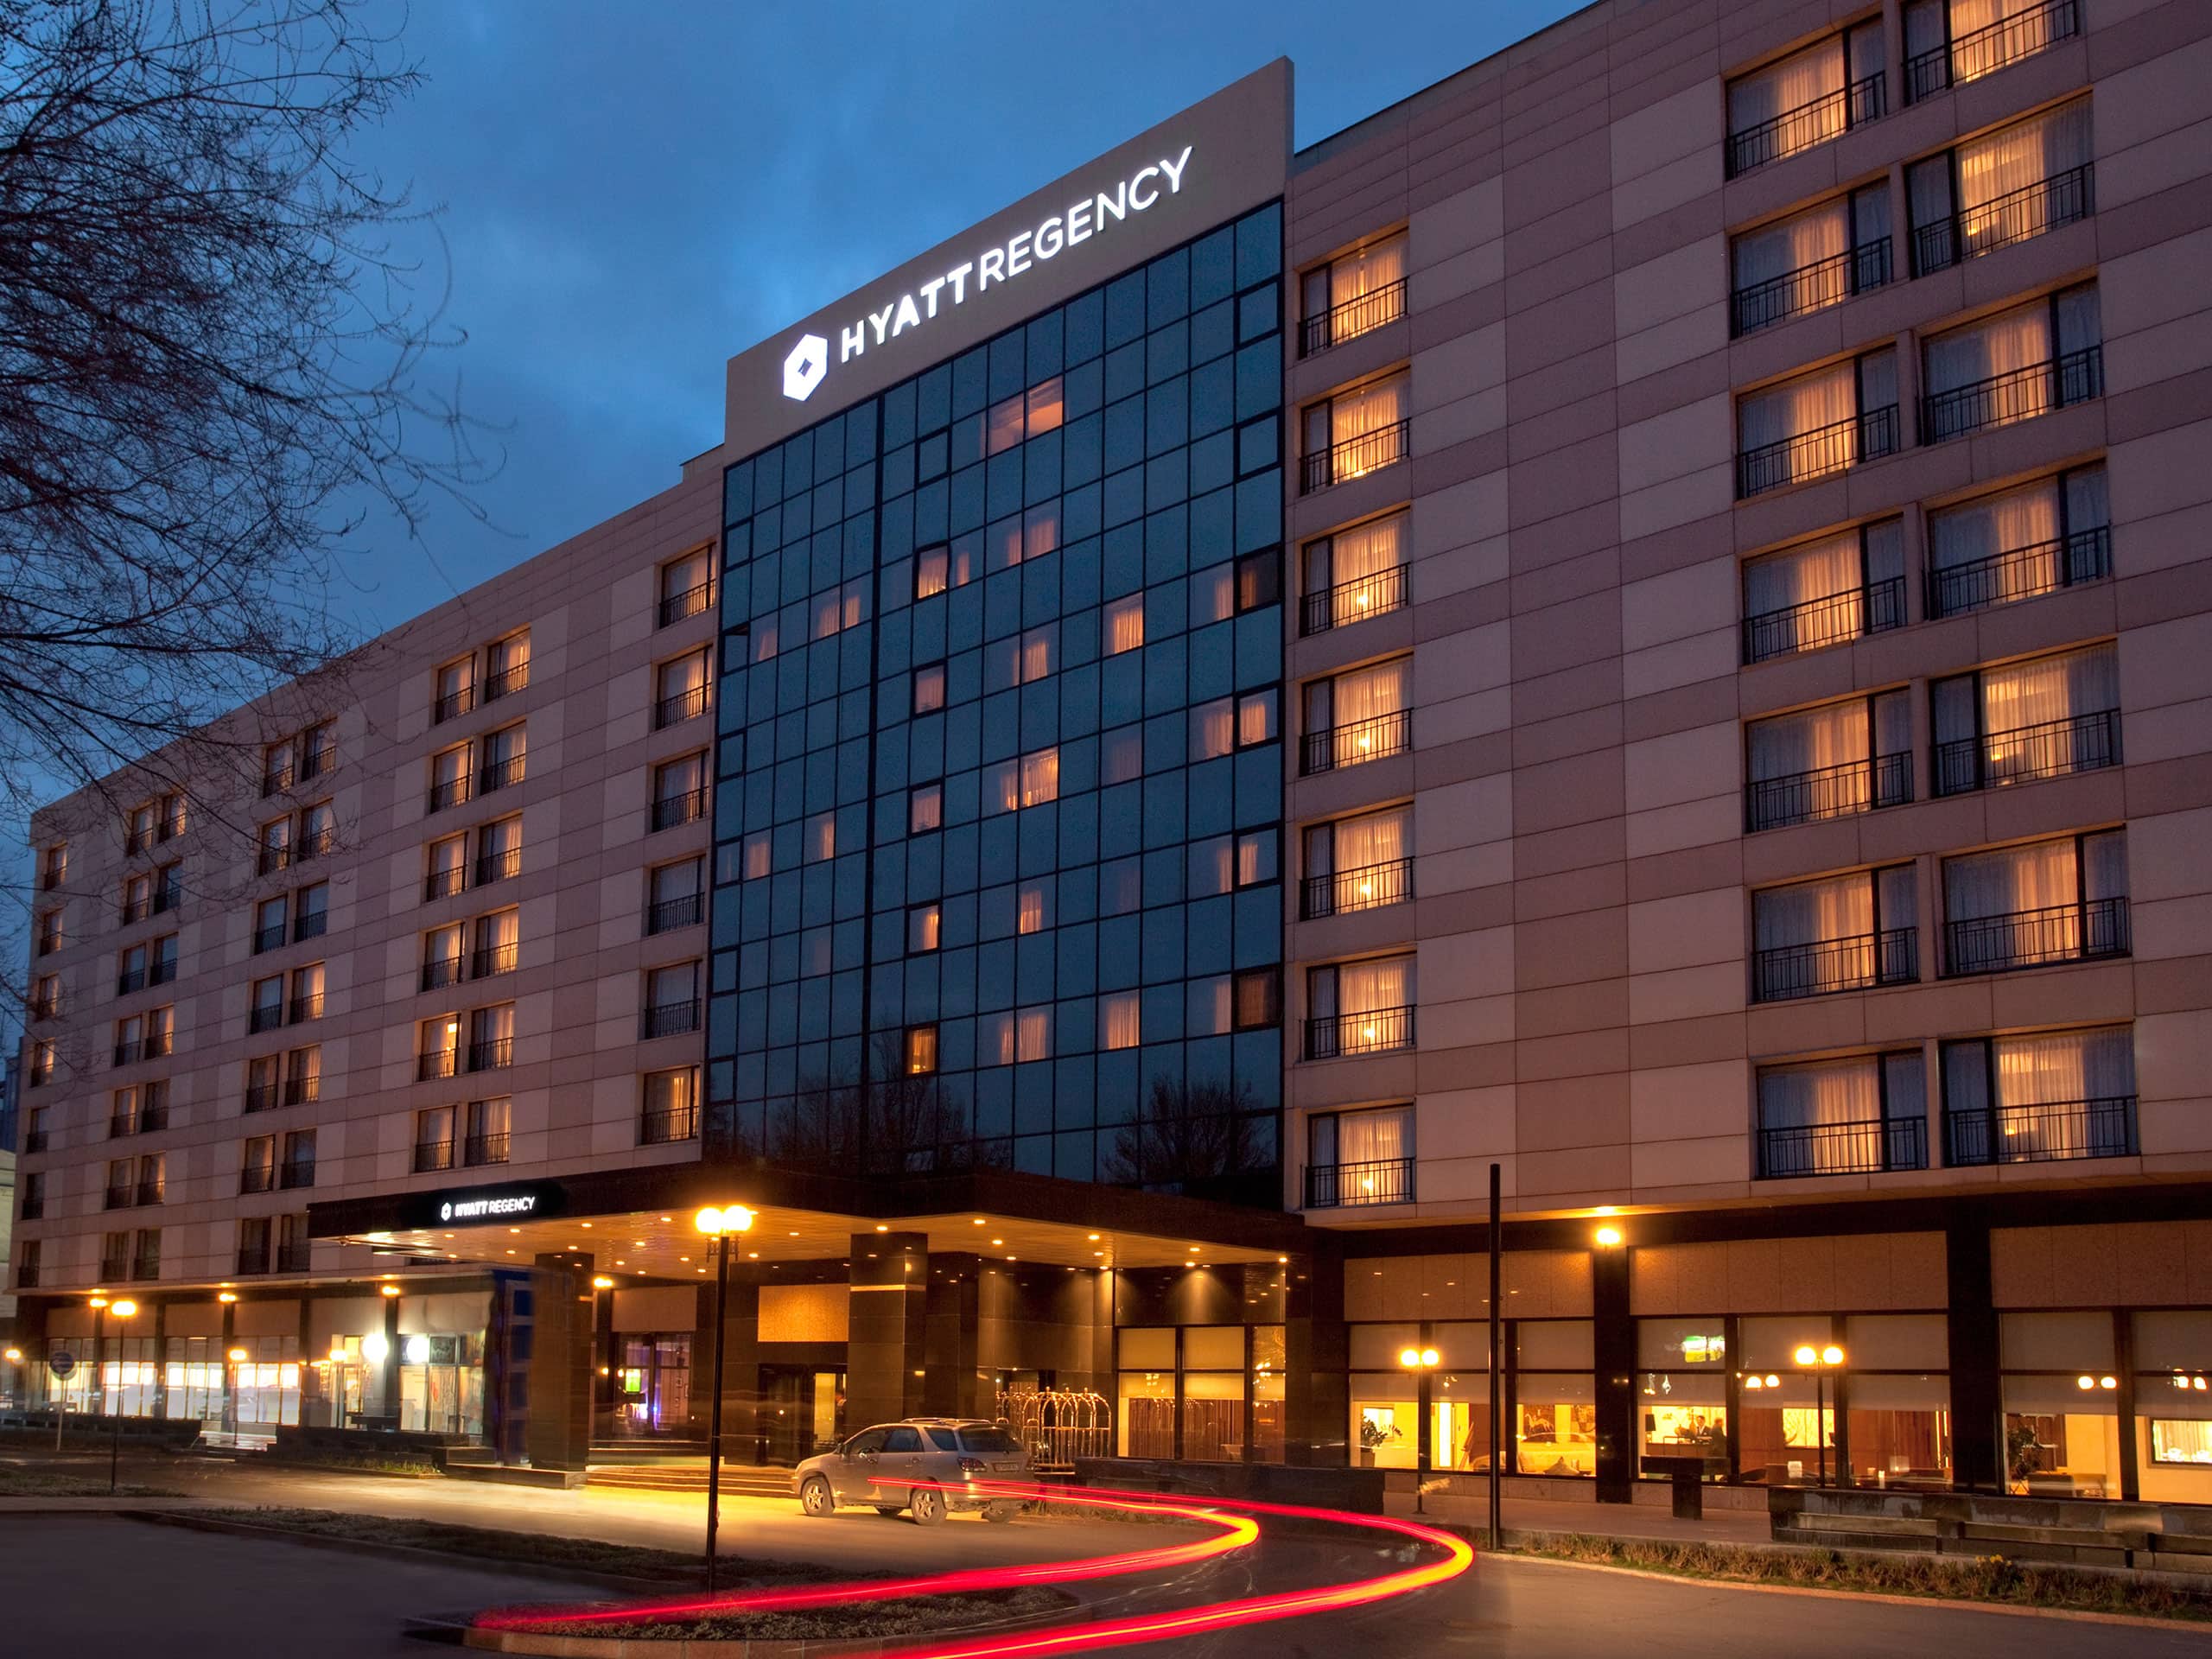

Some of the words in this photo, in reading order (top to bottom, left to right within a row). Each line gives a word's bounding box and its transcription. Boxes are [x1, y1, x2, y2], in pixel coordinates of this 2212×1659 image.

[841, 262, 973, 363] HYATT
[980, 146, 1192, 291] REGENCY
[455, 1200, 488, 1217] HYATT
[489, 1197, 535, 1213] REGENCY
